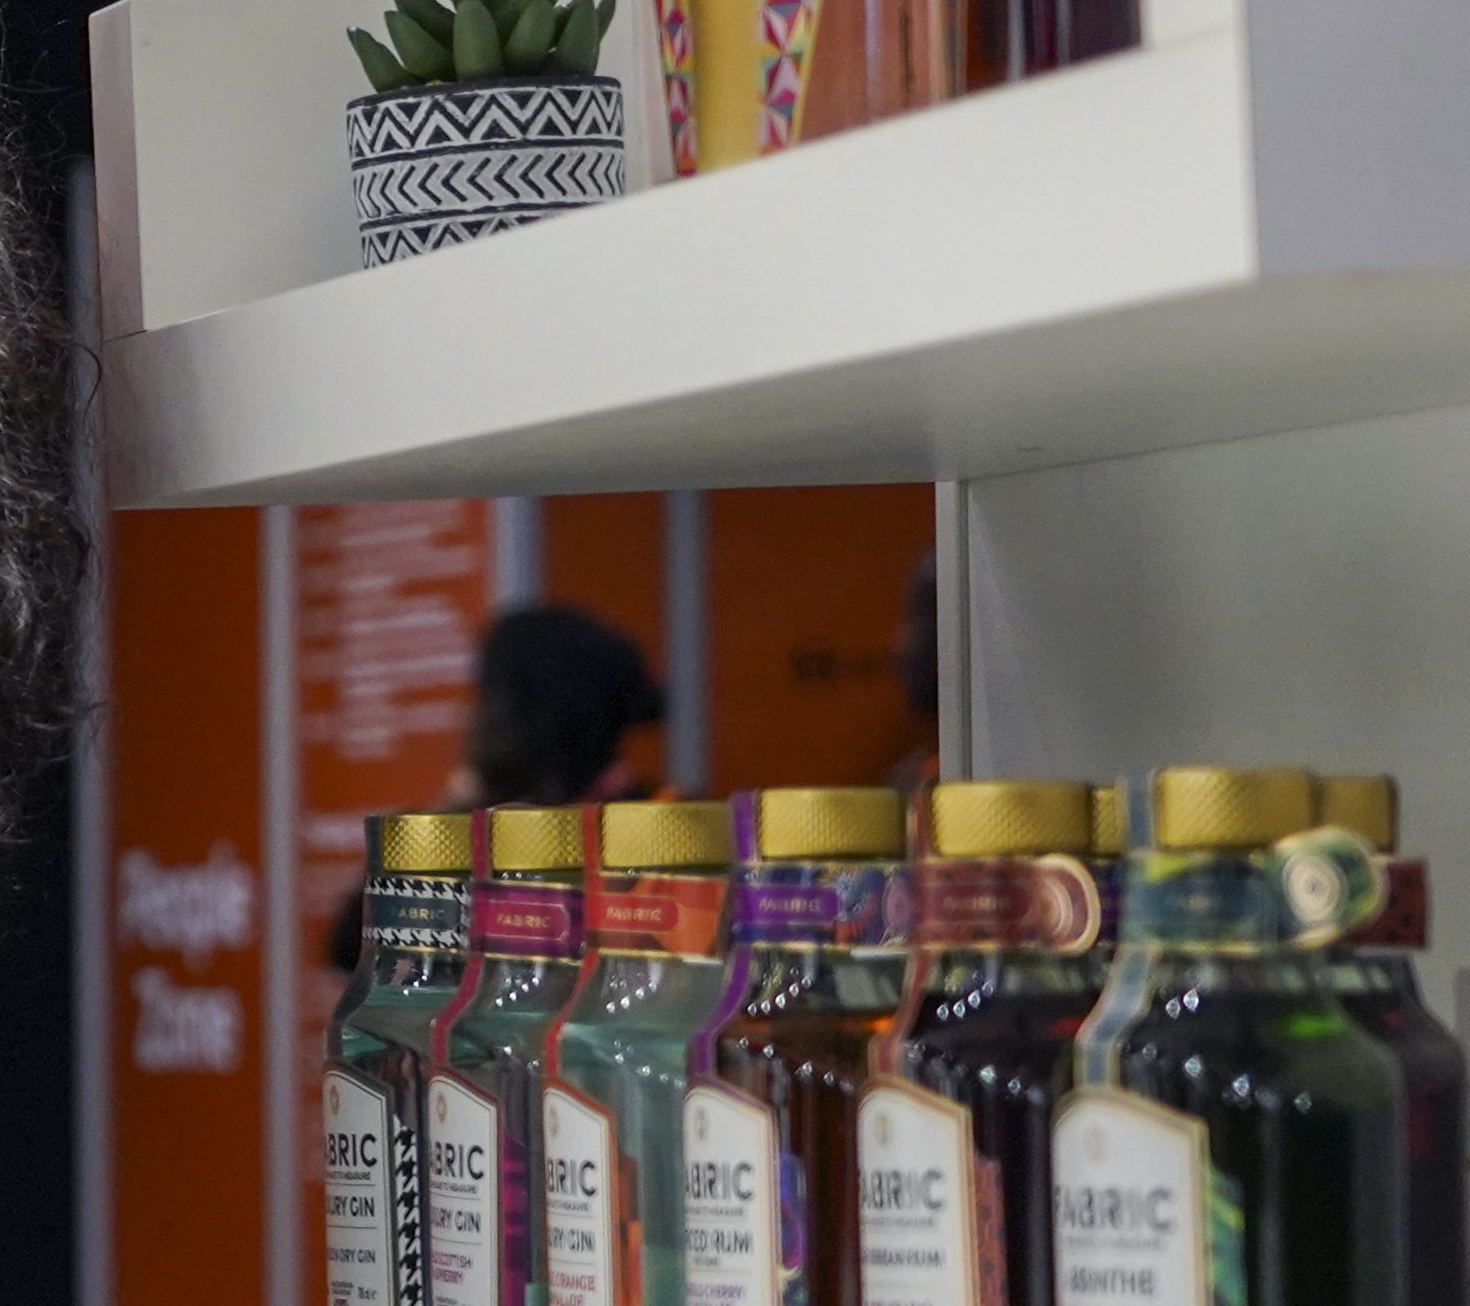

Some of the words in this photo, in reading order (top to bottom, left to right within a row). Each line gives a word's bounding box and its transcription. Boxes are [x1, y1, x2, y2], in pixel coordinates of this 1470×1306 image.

[396, 905, 446, 923] ABRIC
[497, 912, 552, 930] FABRIC
[326, 1132, 378, 1168] BRIC
[431, 1141, 485, 1181] BRIC
[547, 1158, 598, 1197] BRIC
[685, 1161, 755, 1202] BRIC
[860, 1168, 945, 1211] ABRIC
[350, 1196, 375, 1218] GIN
[454, 1210, 482, 1234] GIN
